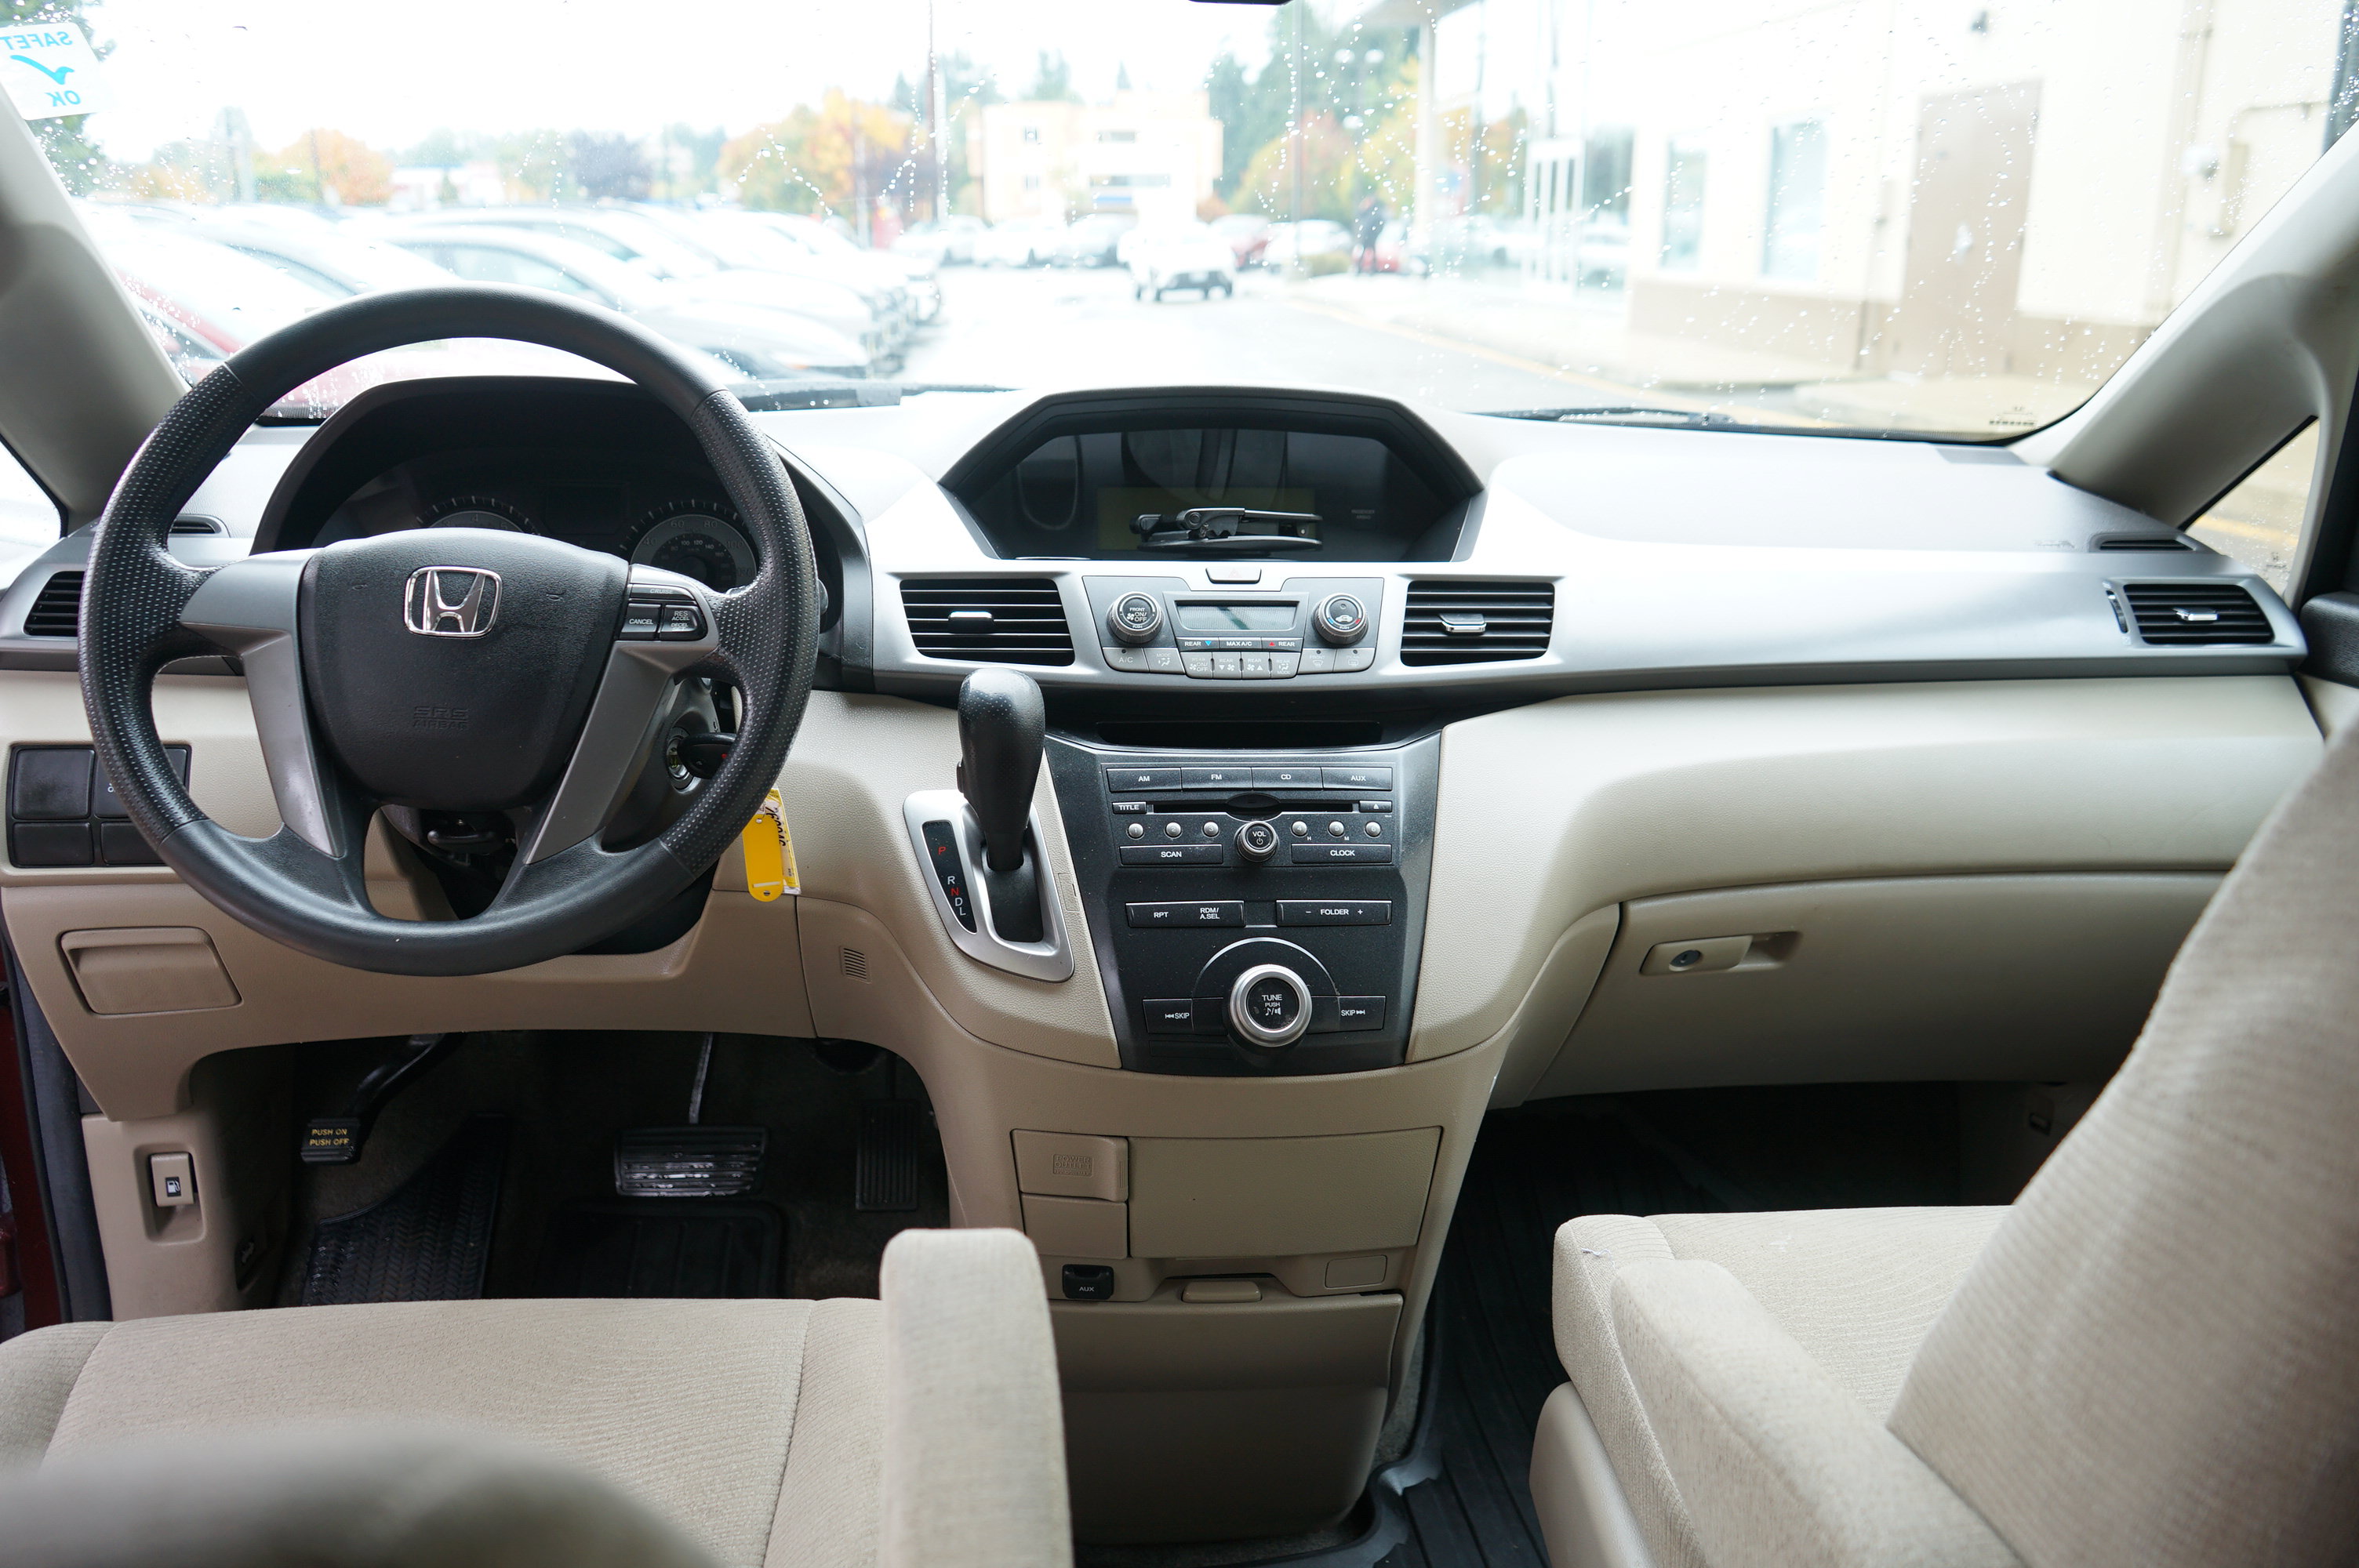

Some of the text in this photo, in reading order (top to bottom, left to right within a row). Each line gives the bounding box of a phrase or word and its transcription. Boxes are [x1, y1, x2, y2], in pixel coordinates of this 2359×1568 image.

[938, 846, 947, 855] P
[947, 876, 955, 884] R
[951, 887, 959, 896] N
[955, 898, 963, 906] D
[959, 907, 966, 916] L
